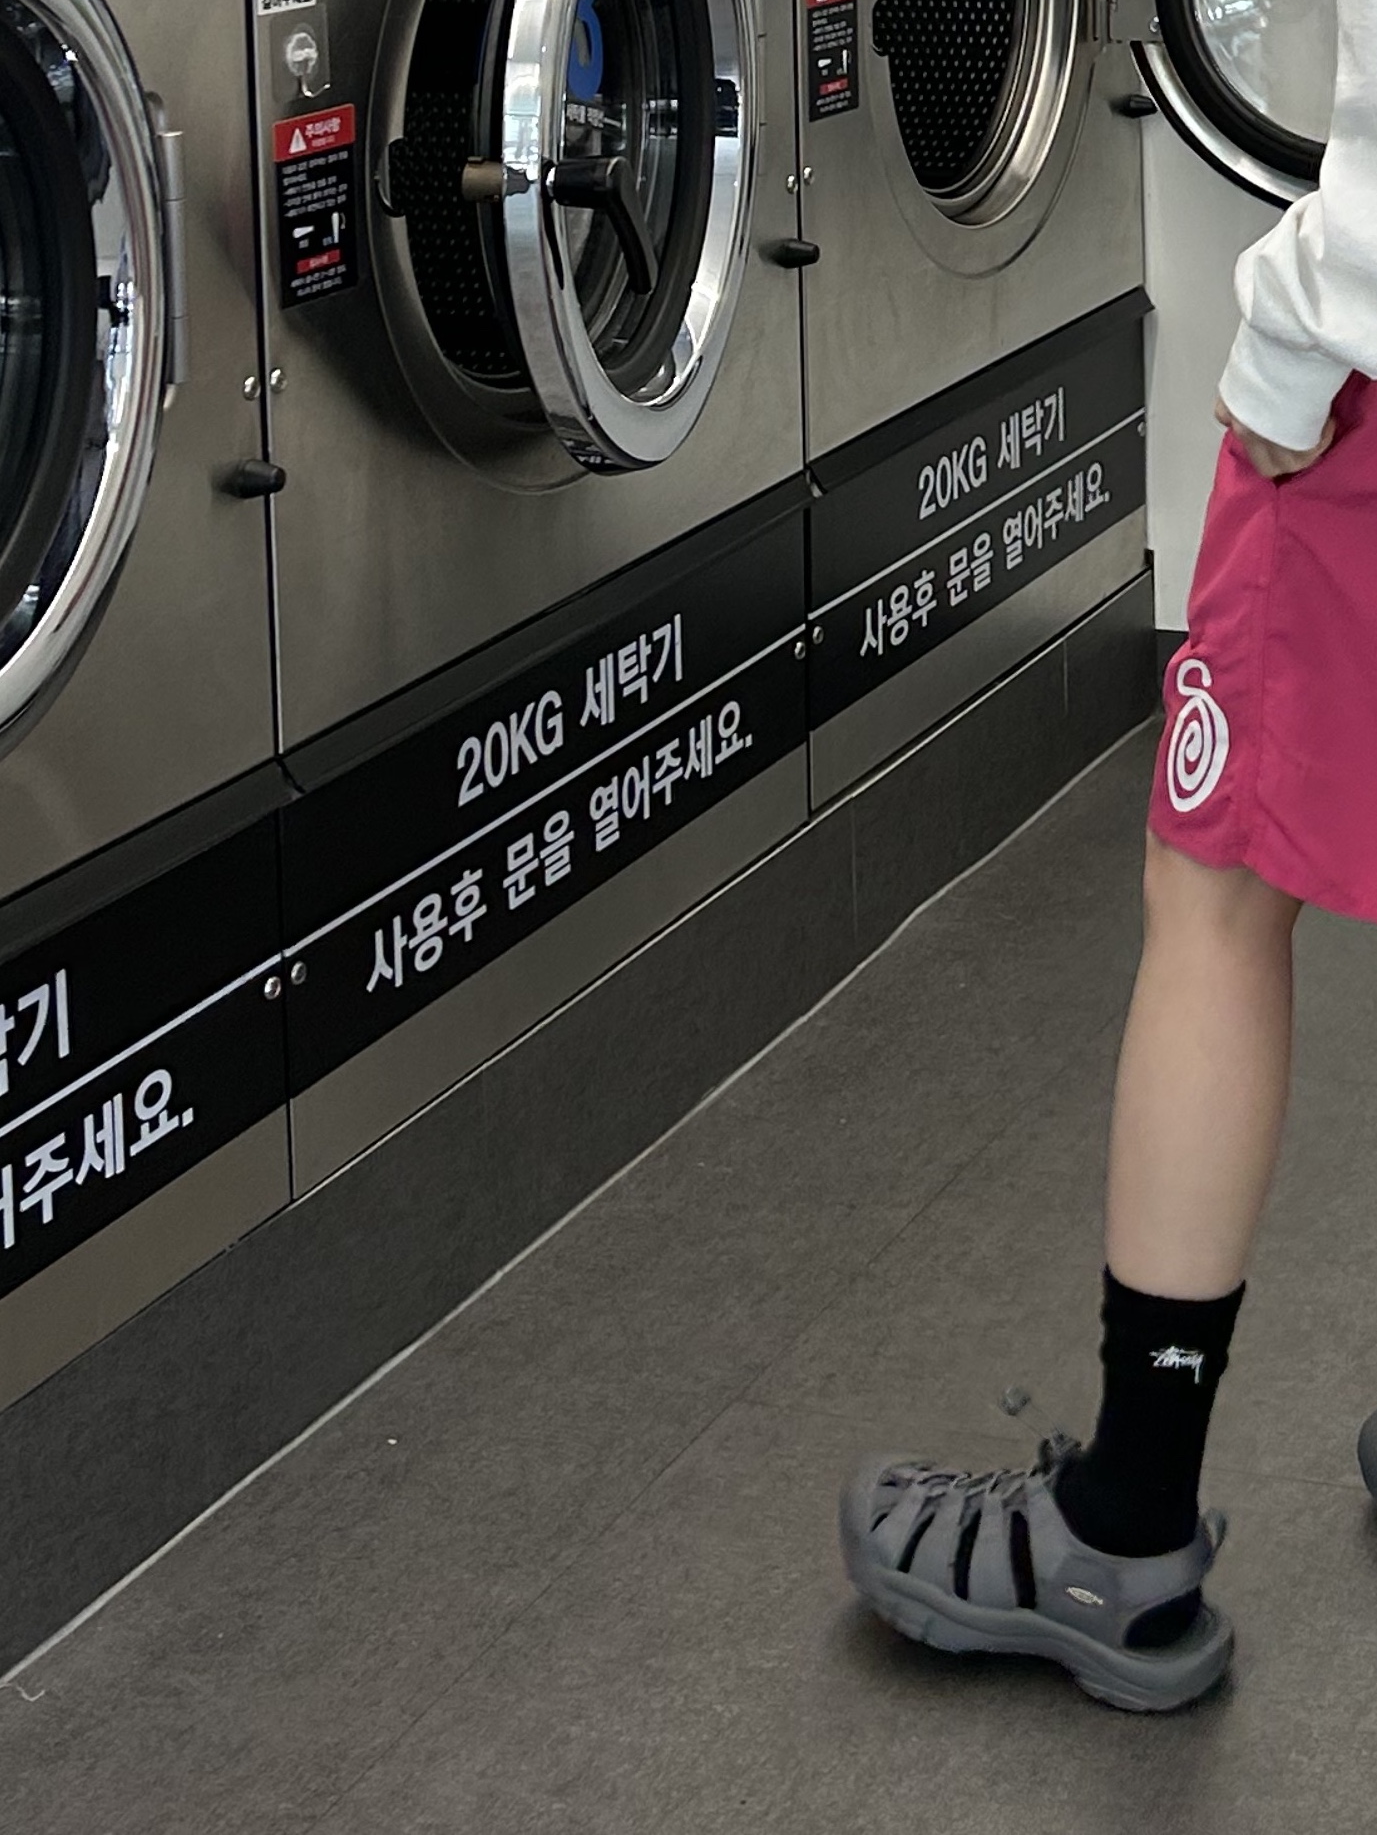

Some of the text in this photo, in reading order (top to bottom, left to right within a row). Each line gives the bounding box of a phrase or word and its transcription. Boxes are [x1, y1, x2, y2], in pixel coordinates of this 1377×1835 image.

[918, 386, 1065, 520] 20KG 세탁기
[860, 462, 1110, 656] 사용후 문을 열어주세요.
[457, 613, 683, 808] 20KG 세탁기
[366, 700, 753, 993] 사용후 문을 열어주세요.
